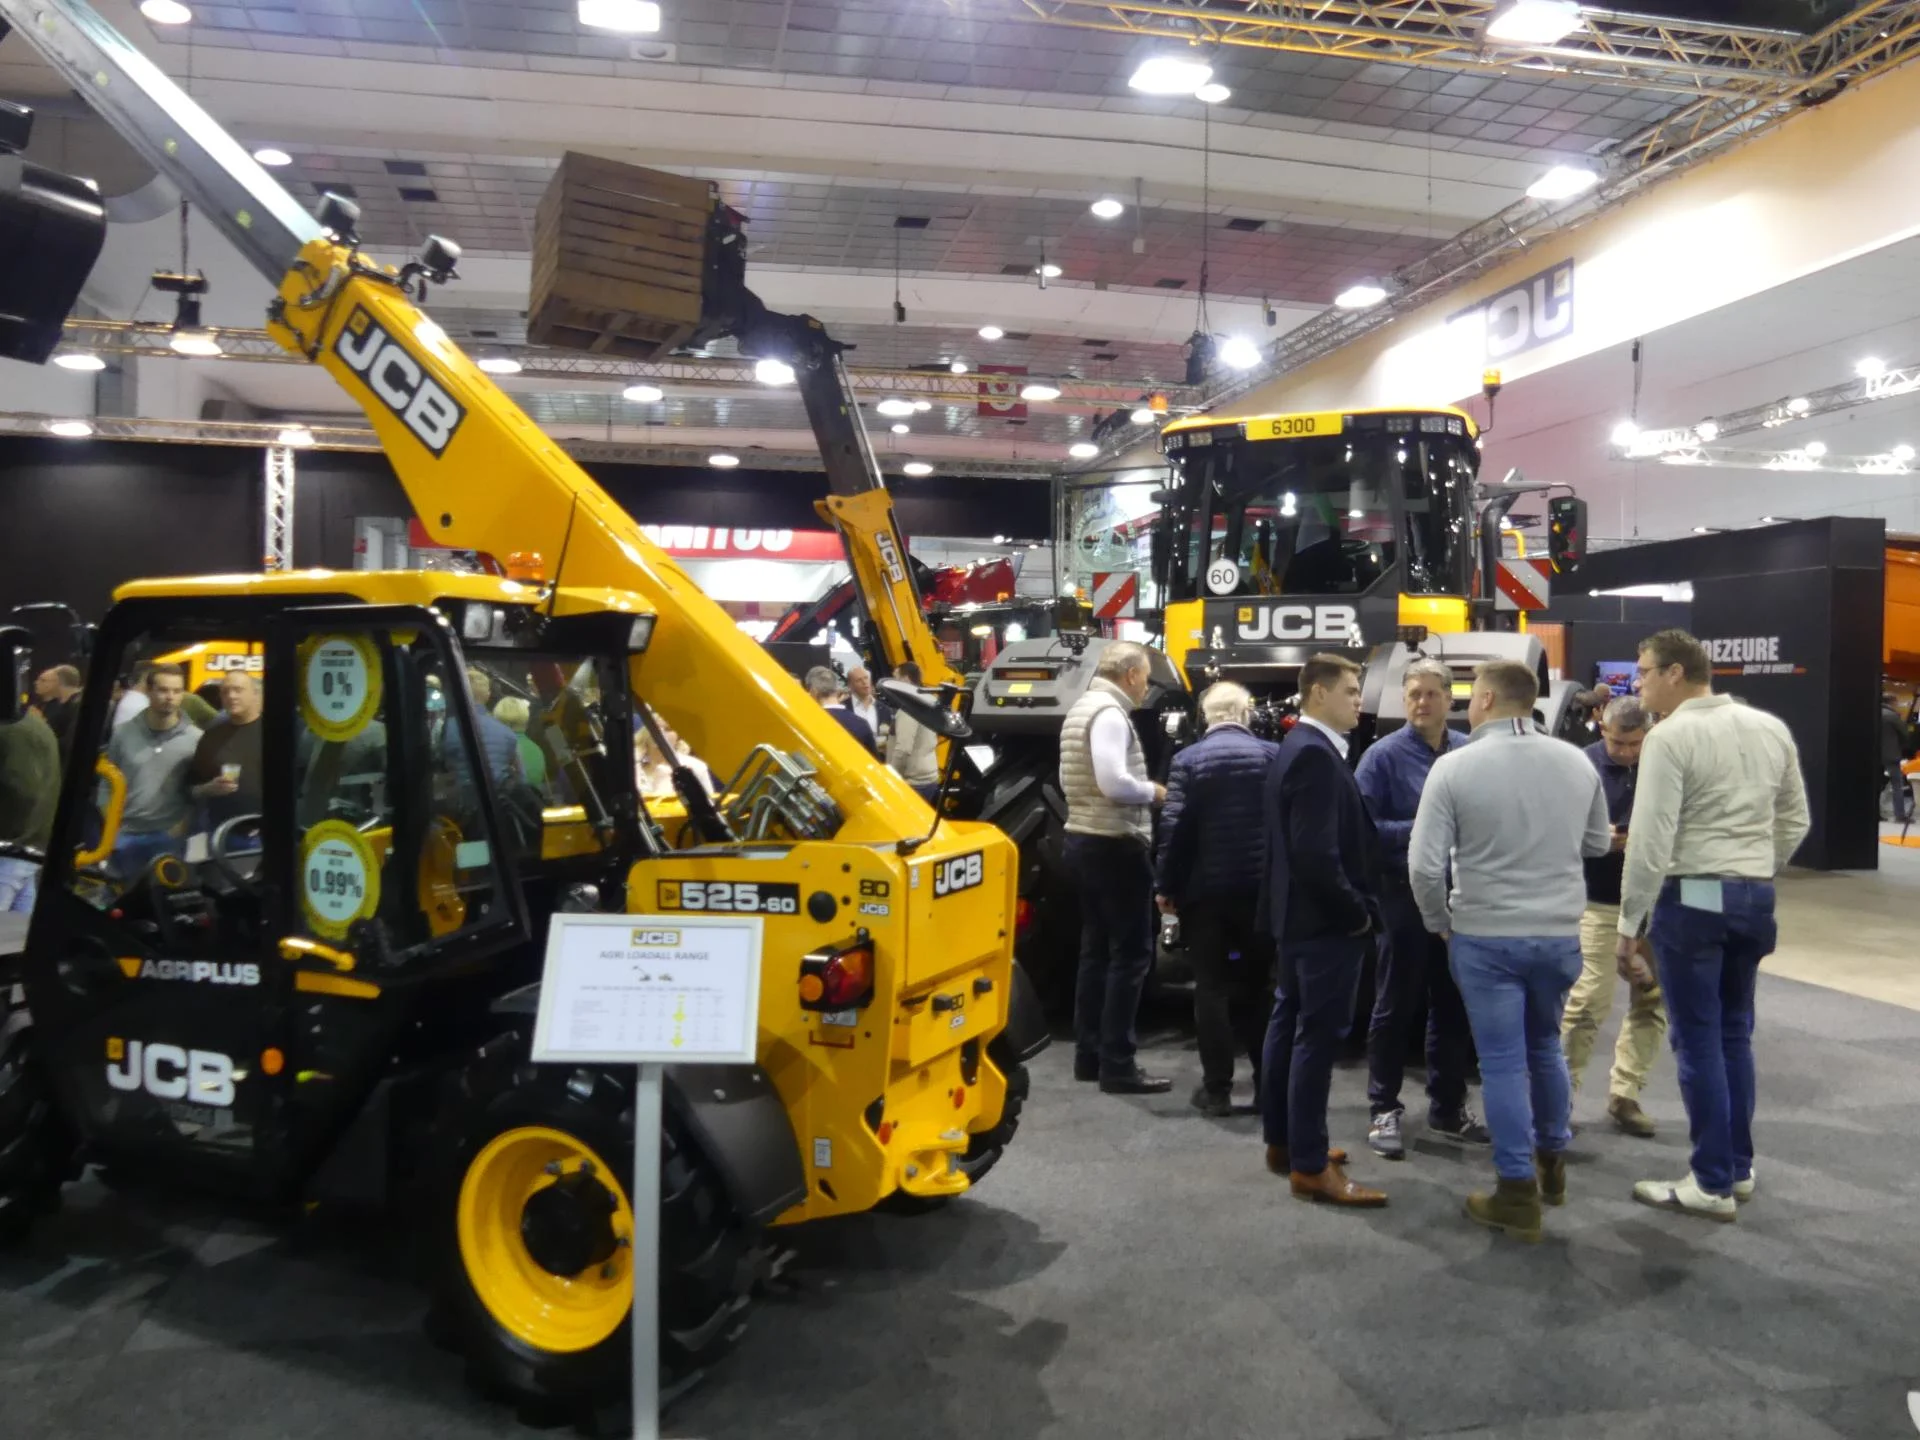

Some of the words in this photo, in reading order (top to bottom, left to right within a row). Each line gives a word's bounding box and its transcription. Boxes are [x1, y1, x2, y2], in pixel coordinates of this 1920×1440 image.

[337, 326, 461, 451] JCB
[1271, 417, 1316, 435] 6300
[874, 531, 906, 584] JCB
[1210, 568, 1236, 586] 60
[1237, 604, 1357, 641] JCB
[858, 878, 891, 899] 80
[935, 854, 983, 897] JCB
[681, 882, 797, 913] 525-60
[858, 902, 890, 917] JCB
[633, 929, 678, 946] JCB
[599, 949, 625, 961] AGRI
[673, 950, 711, 962] RANGE
[105, 1039, 237, 1108] JCB
